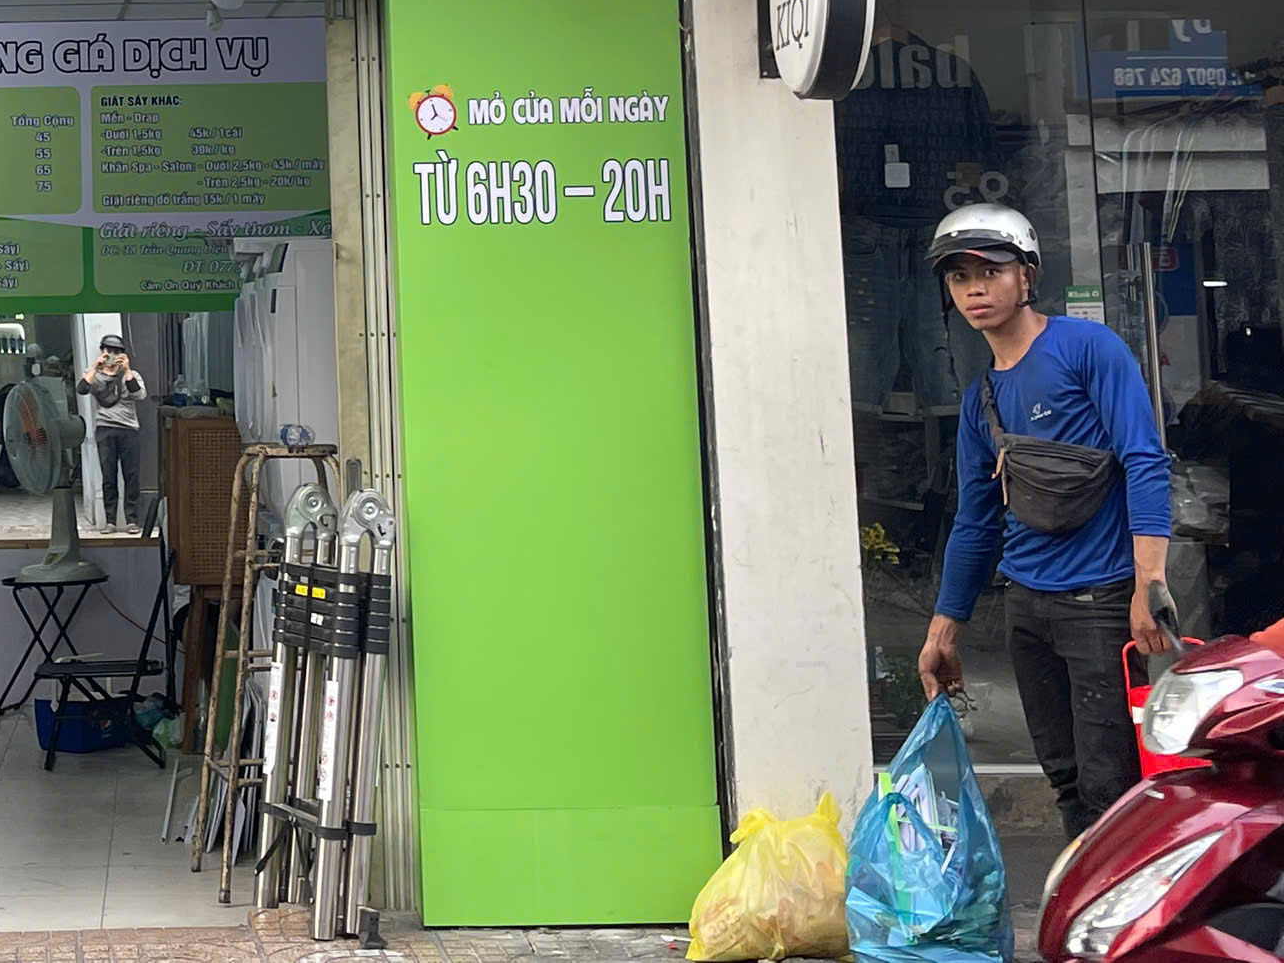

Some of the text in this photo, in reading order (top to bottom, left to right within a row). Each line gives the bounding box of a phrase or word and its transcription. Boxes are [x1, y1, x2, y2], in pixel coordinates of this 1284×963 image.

[53, 34, 115, 72] GIÁ
[123, 38, 206, 78] DỊCH
[216, 38, 269, 77] VỤ
[559, 87, 604, 123] MỖI
[608, 90, 669, 123] NGÀY
[36, 132, 51, 142] 45
[36, 149, 51, 159] 55
[36, 165, 52, 175] 65
[37, 182, 52, 192] 75
[413, 149, 458, 225] TỪ
[466, 160, 557, 225] 6H30
[602, 158, 671, 222] 20H
